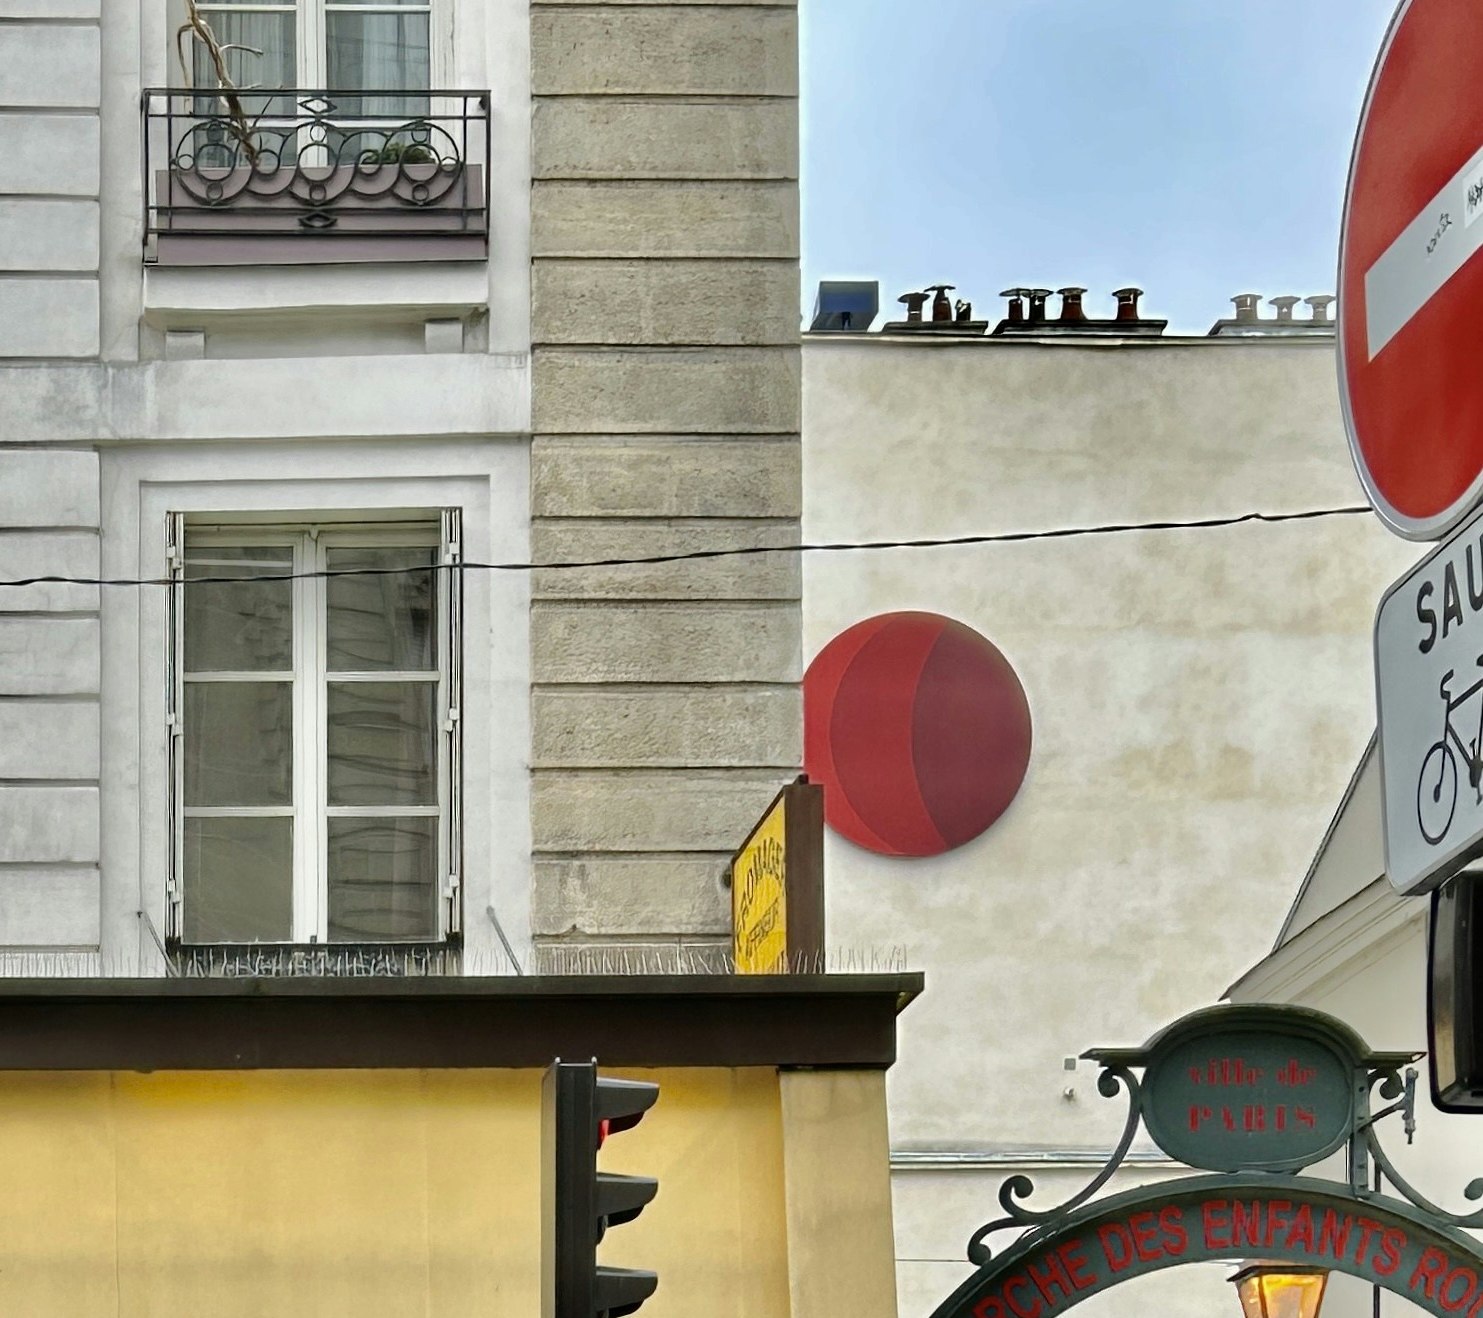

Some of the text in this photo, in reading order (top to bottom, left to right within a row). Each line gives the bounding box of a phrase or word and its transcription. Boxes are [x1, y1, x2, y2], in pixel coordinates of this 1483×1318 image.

[1189, 1103, 1316, 1133] PARIS
[1097, 1205, 1190, 1276] DES
[1201, 1199, 1408, 1278] ENFANTS
